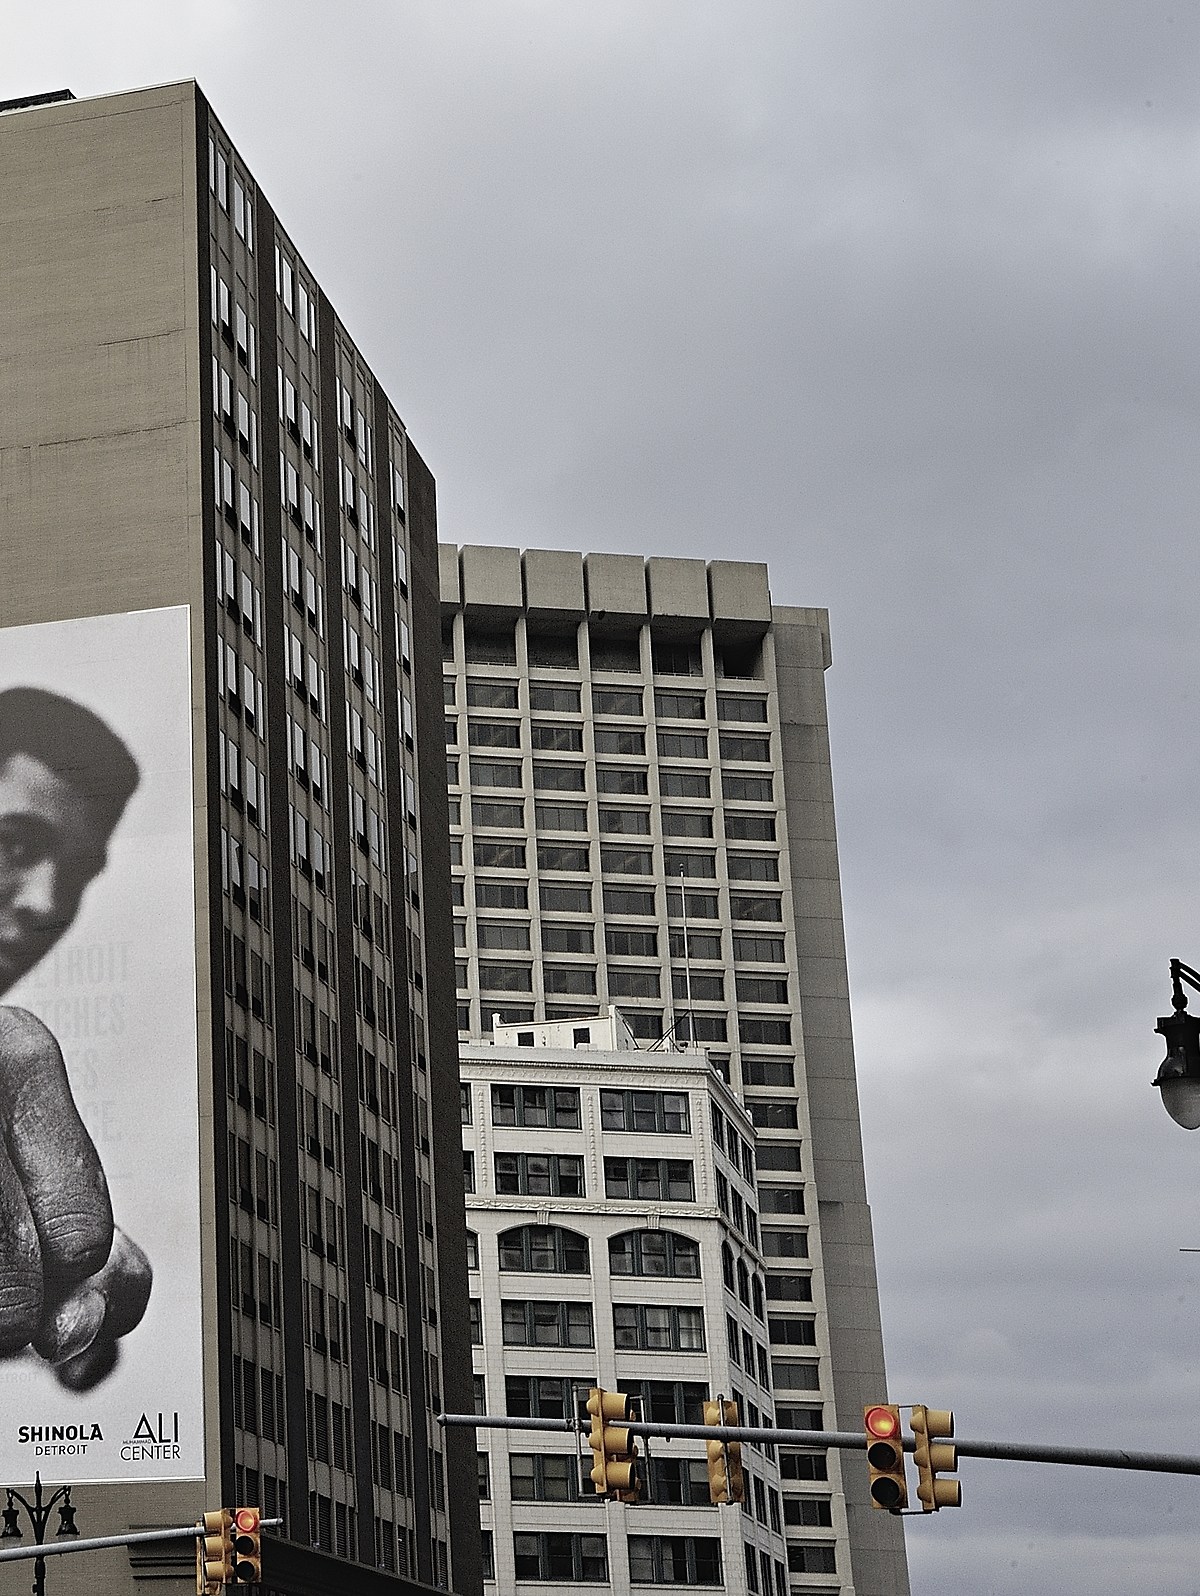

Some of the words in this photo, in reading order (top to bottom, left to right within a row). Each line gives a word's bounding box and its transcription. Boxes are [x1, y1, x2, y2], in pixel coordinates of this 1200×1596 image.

[18, 1423, 104, 1443] SHINOLA
[133, 1412, 179, 1443] ALI
[35, 1444, 88, 1456] DETROIT
[120, 1444, 181, 1461] CENTER
